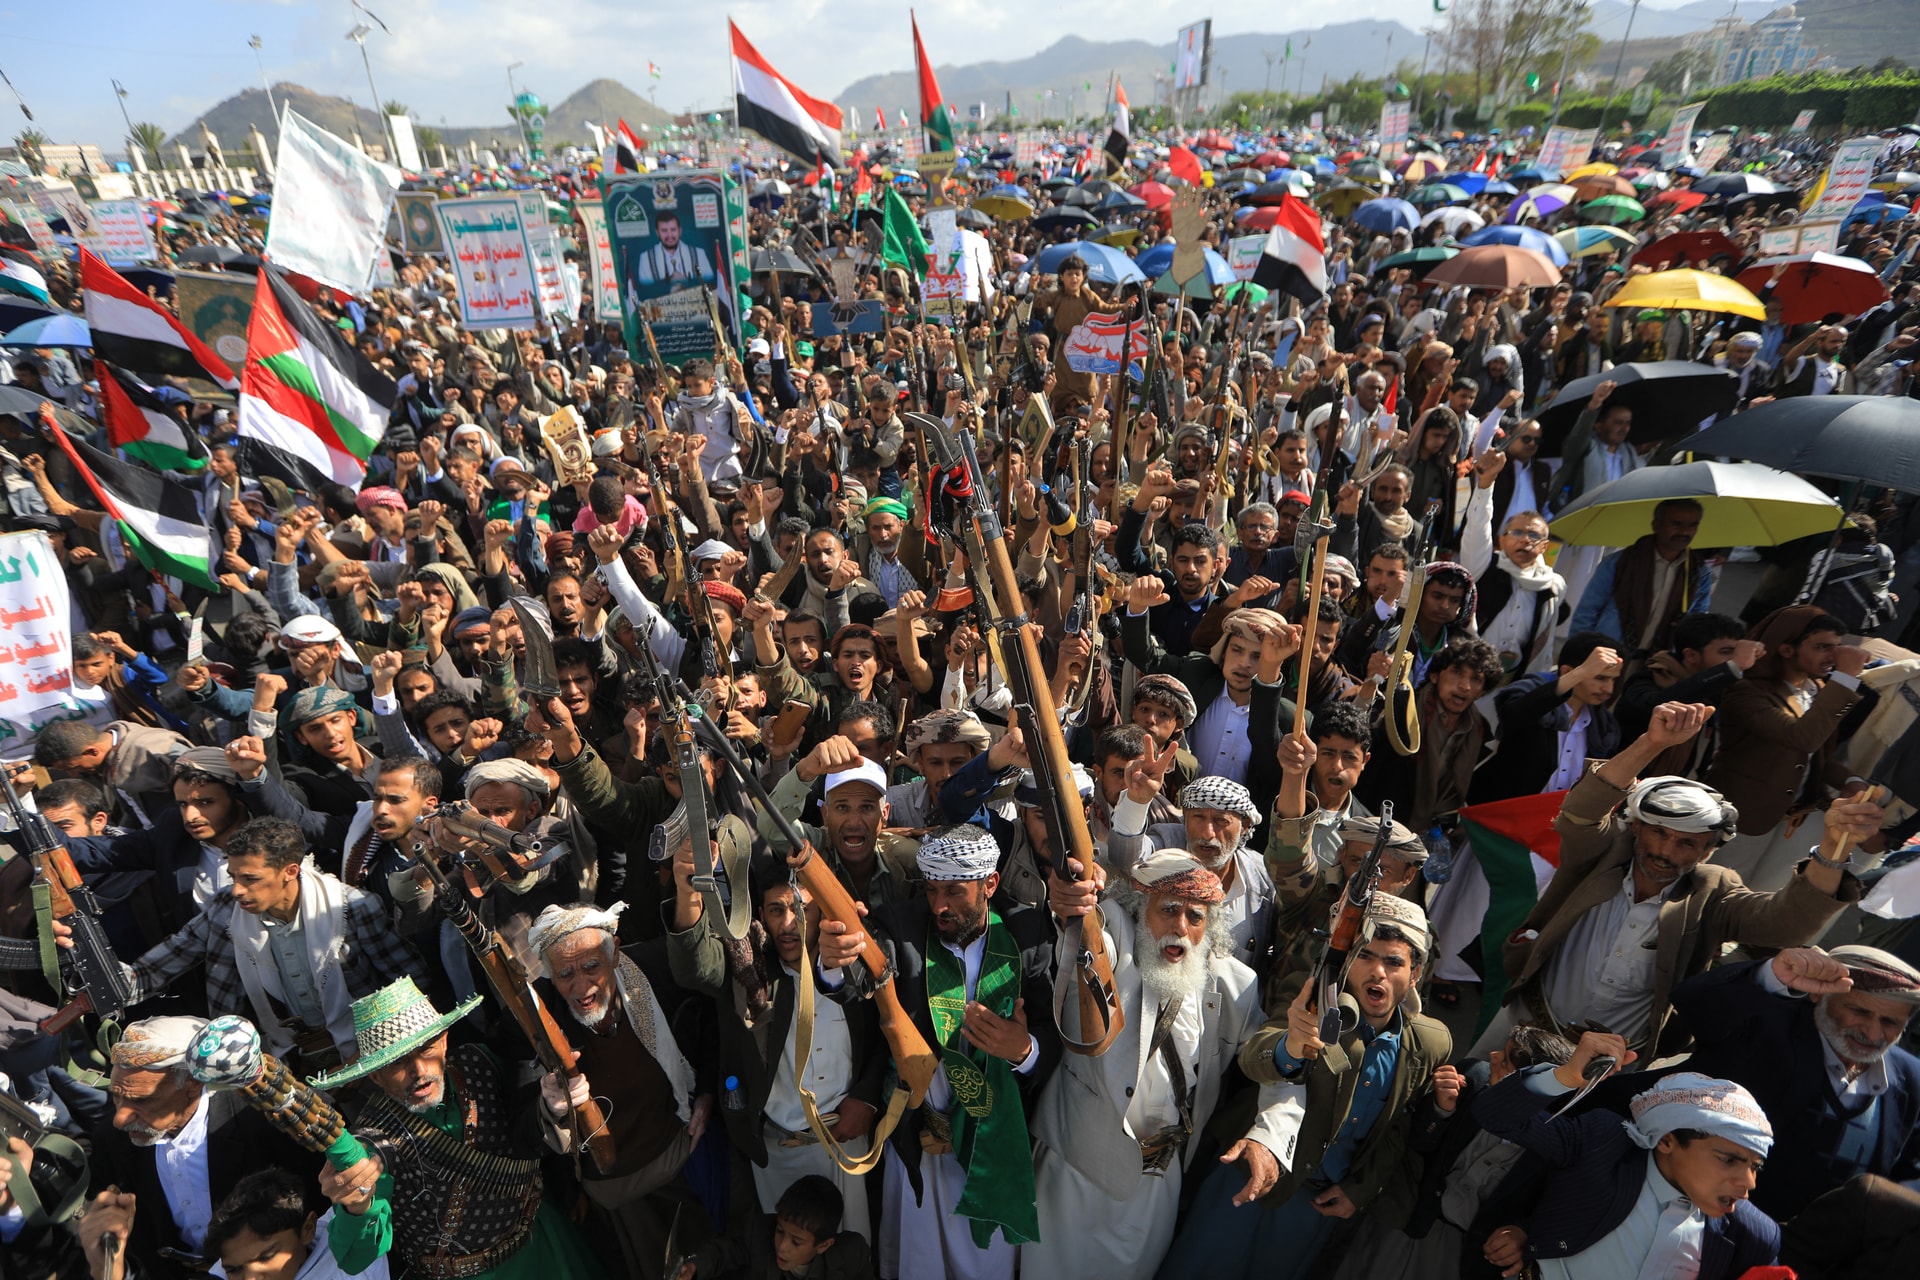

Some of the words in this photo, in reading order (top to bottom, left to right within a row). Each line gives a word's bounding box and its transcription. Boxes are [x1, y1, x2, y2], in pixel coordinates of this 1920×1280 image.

[446, 211, 518, 239] قاطعوا
[491, 242, 523, 264] البضائع
[0, 595, 54, 630] المو
